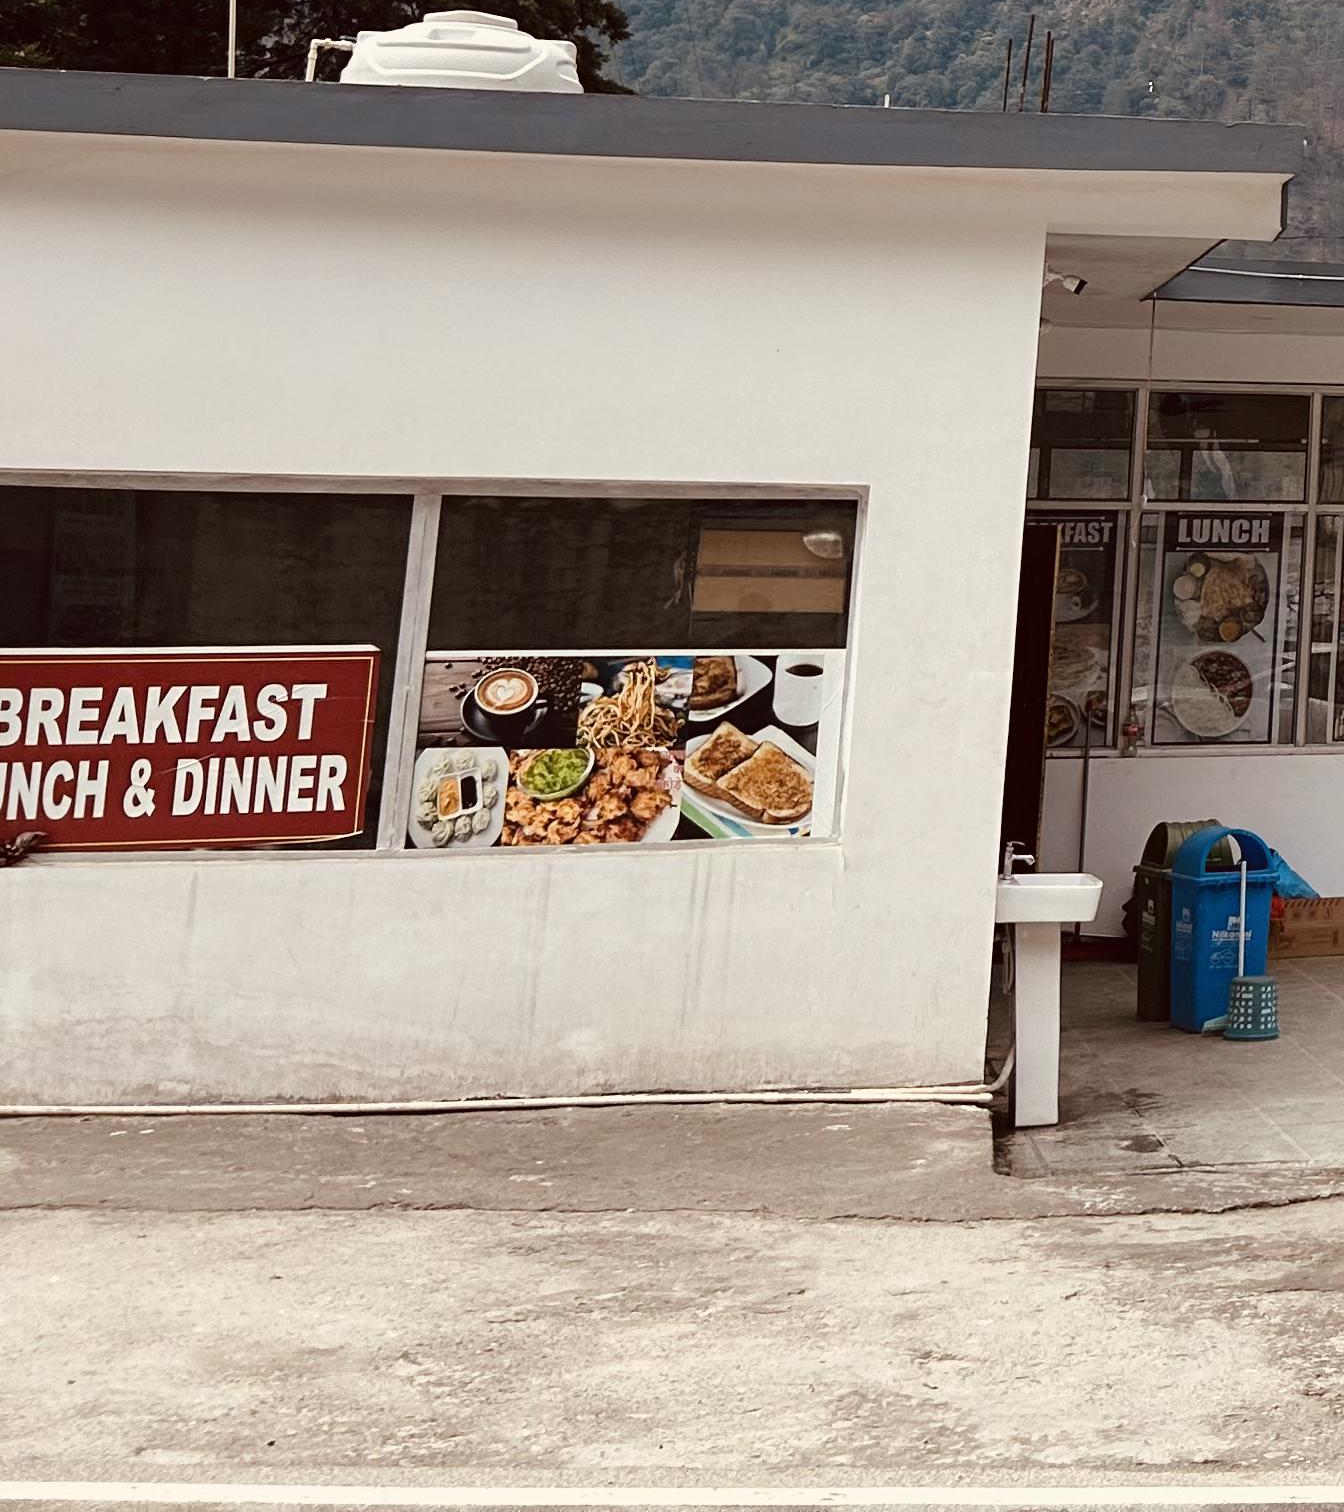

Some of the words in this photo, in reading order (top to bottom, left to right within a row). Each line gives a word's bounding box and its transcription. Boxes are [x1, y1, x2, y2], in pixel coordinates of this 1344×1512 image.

[1177, 518, 1270, 543] LUNCH
[0, 683, 327, 746] BREAKFAST
[0, 760, 109, 820] NCH
[123, 758, 155, 818] &
[172, 754, 348, 816] DINNER
